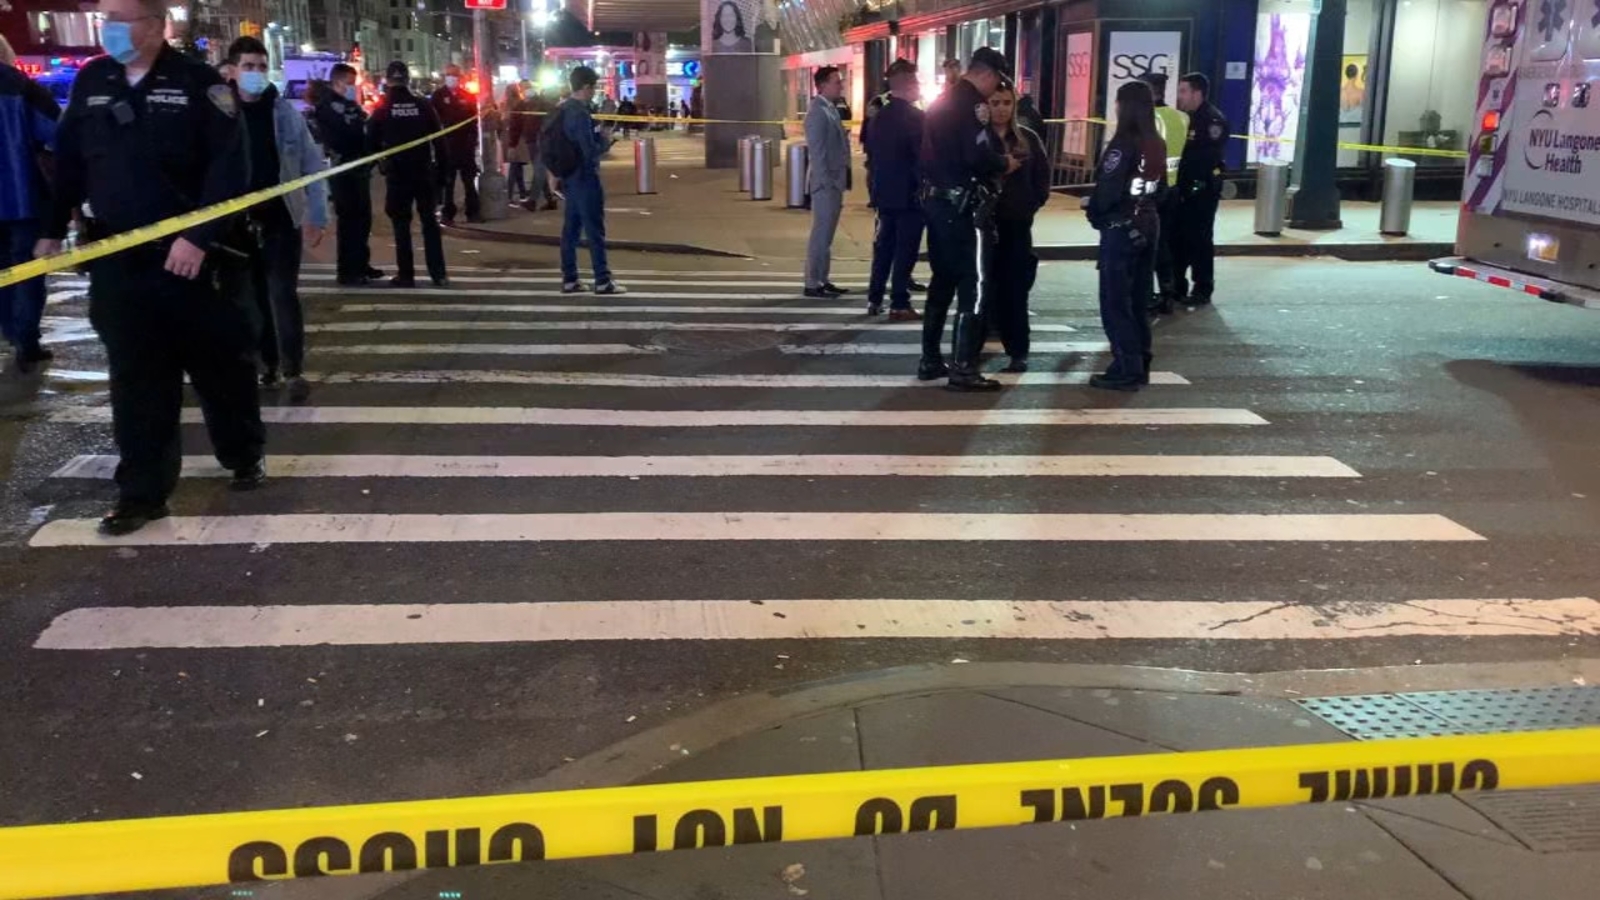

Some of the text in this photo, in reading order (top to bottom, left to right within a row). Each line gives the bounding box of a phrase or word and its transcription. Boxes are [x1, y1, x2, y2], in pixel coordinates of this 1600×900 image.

[1068, 52, 1089, 78] SSG
[1113, 54, 1168, 79] SSG
[147, 96, 188, 105] POLICE
[392, 109, 418, 117] POLICE
[1529, 129, 1600, 153] NYU Langone
[1544, 153, 1582, 174] Health
[1503, 189, 1518, 202] NYU
[1519, 191, 1556, 209] LANGONE
